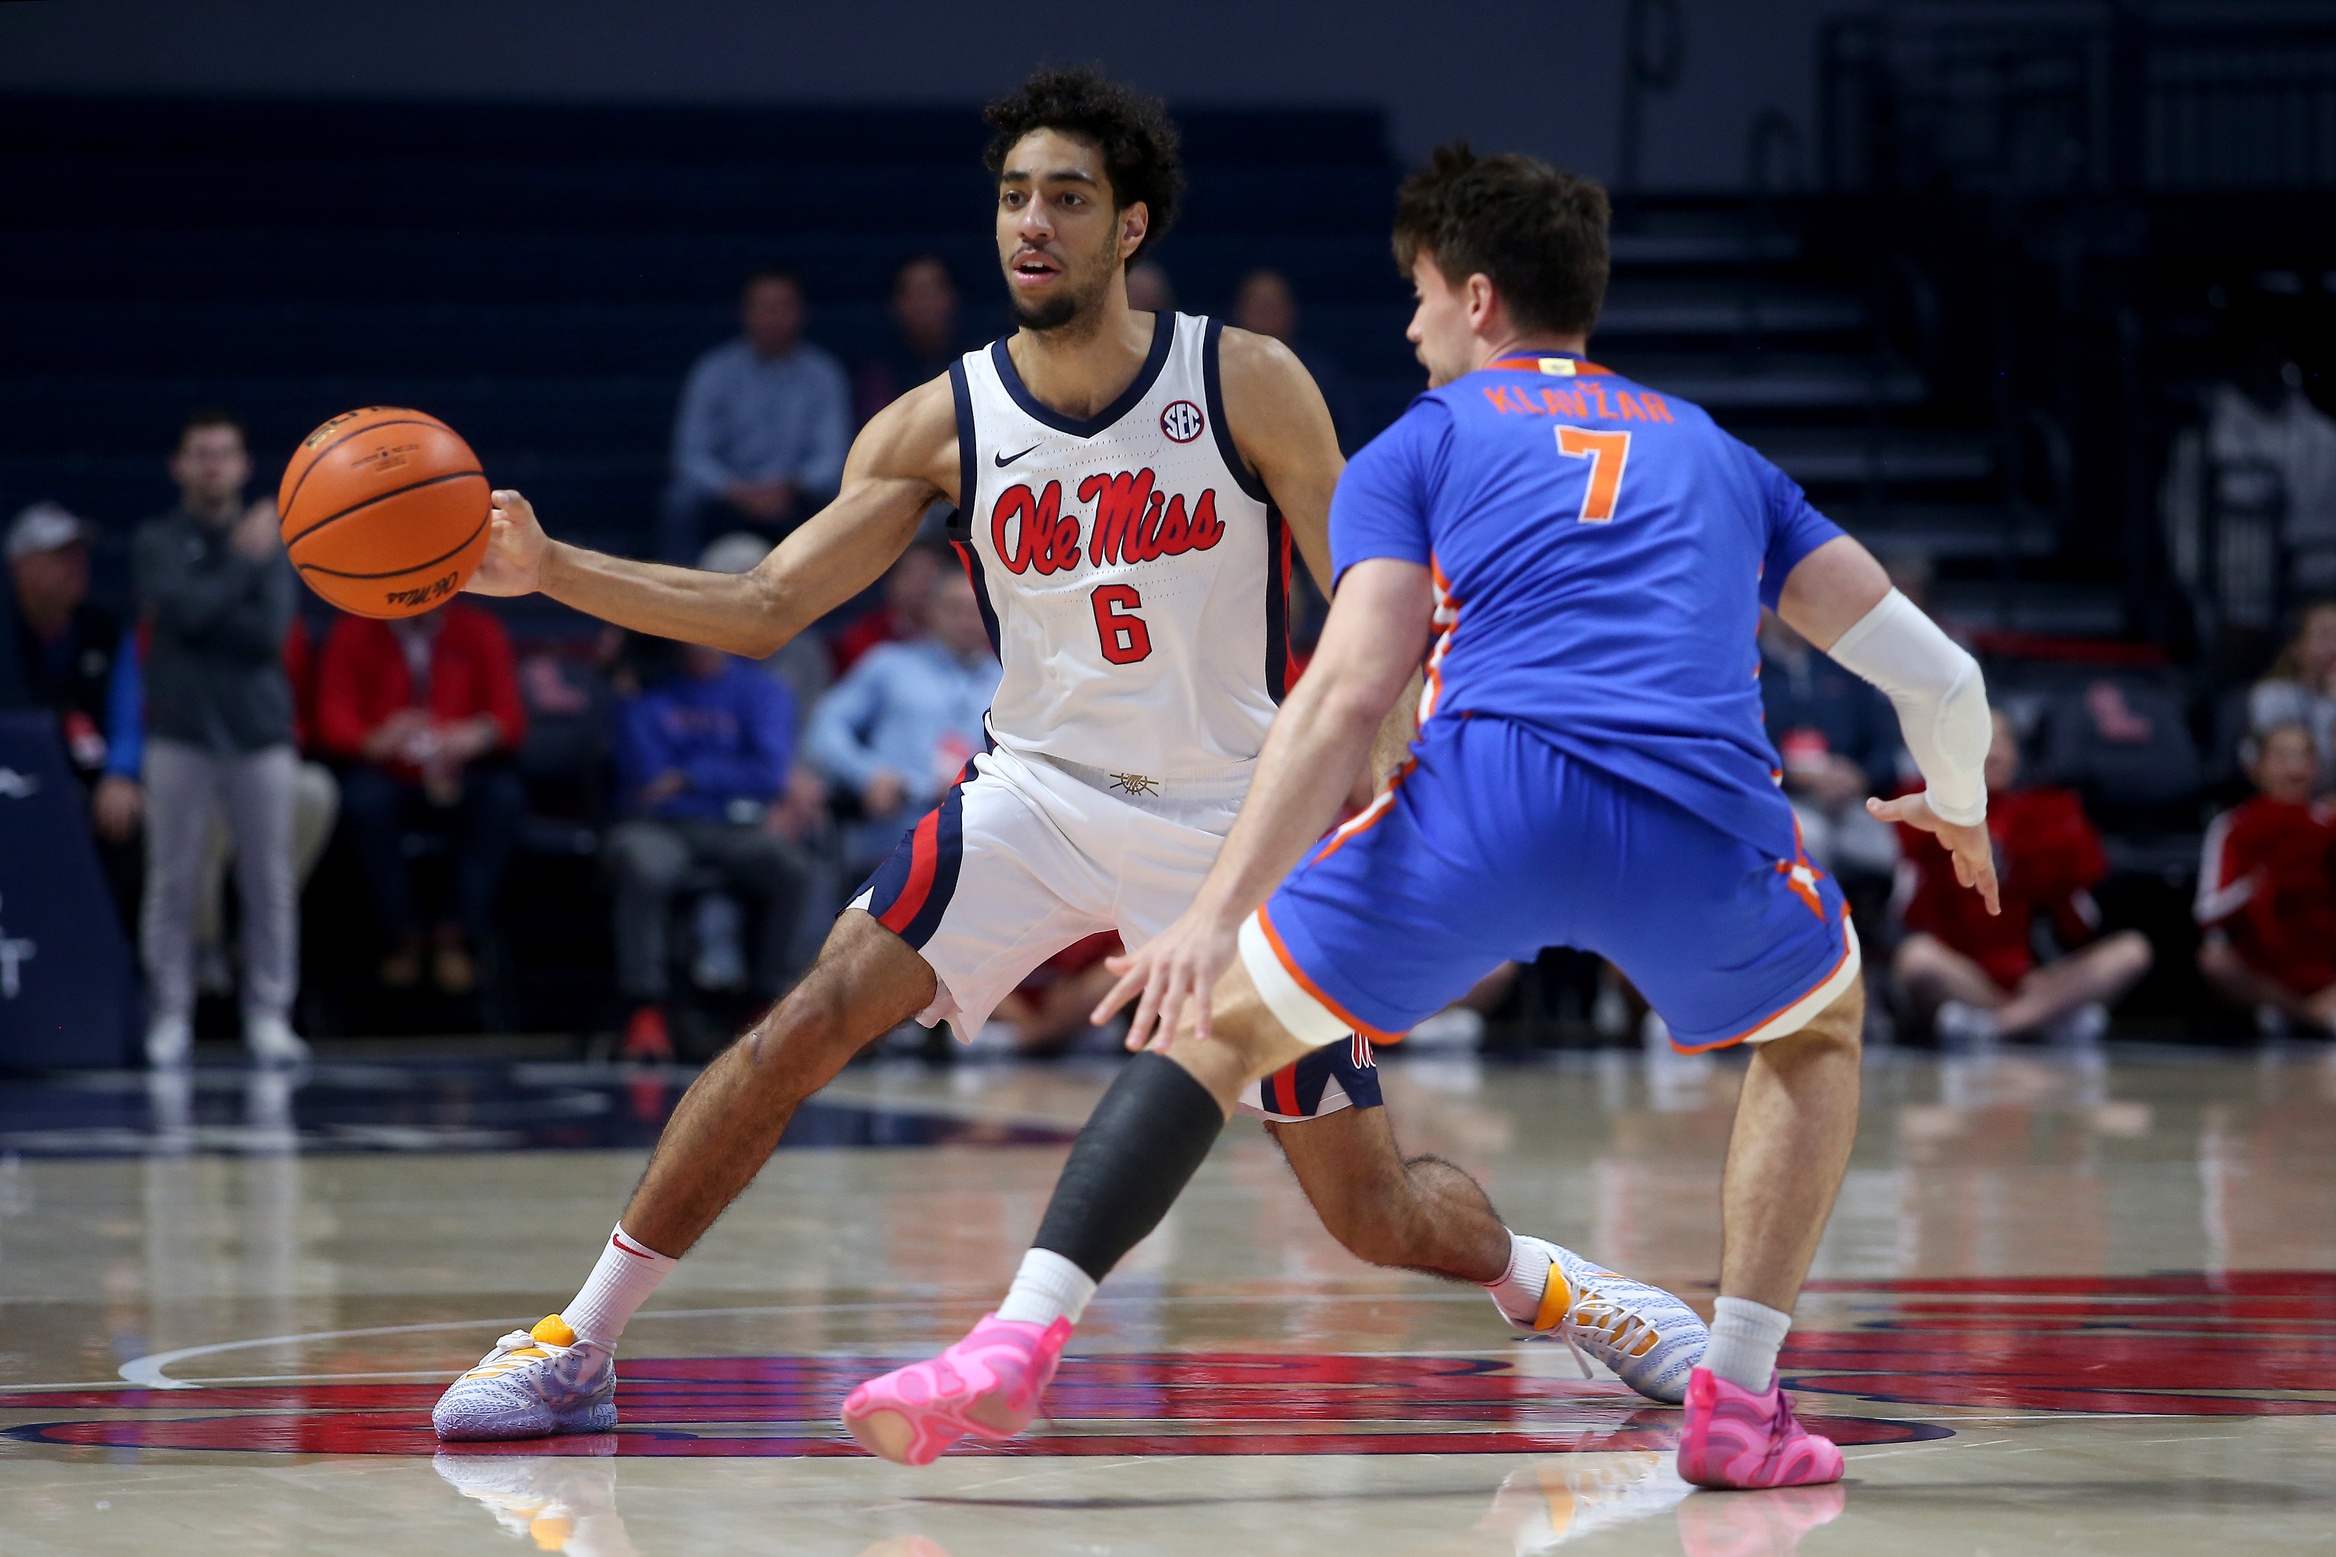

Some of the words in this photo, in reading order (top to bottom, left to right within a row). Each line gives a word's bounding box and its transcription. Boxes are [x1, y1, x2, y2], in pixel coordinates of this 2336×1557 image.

[1163, 402, 1201, 440] SEC
[1483, 381, 1675, 425] KLAVŽAR
[1553, 424, 1632, 524] 7
[990, 479, 1081, 576] Ole
[1076, 466, 1226, 569] Miss
[1090, 584, 1152, 665] 6
